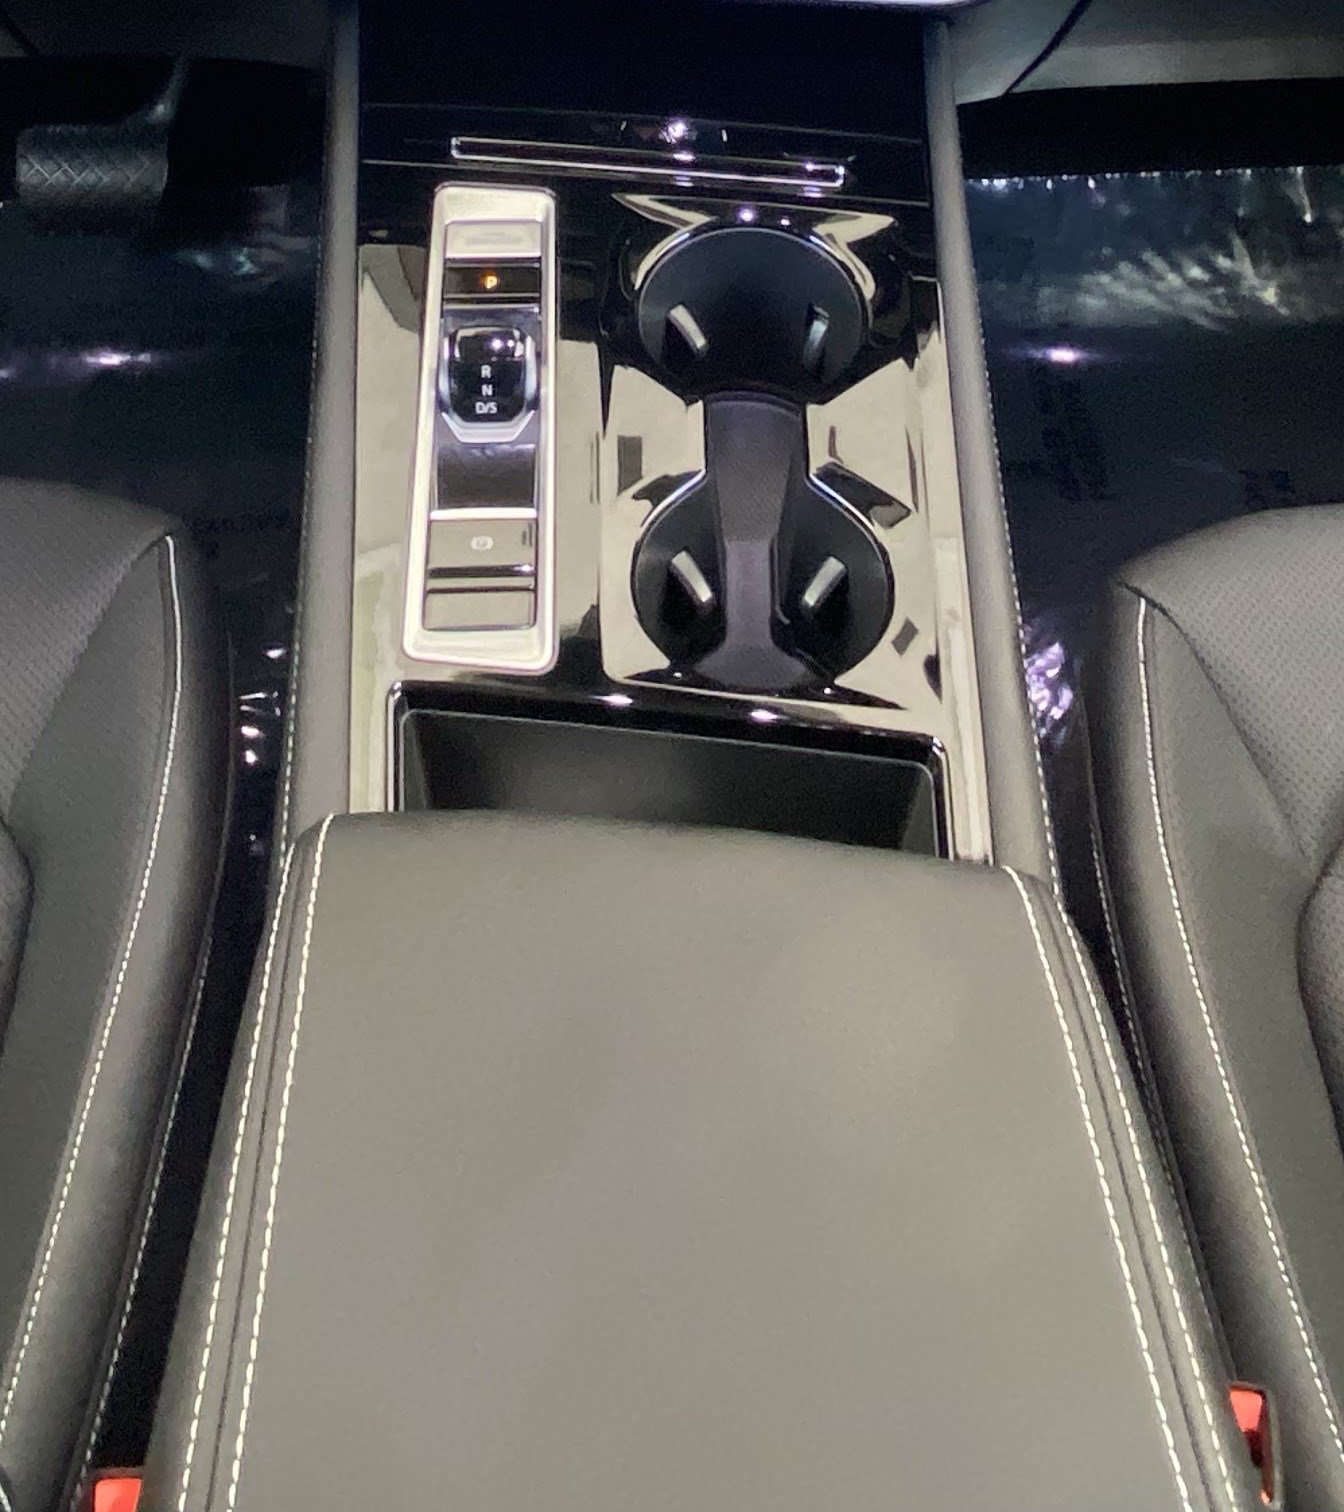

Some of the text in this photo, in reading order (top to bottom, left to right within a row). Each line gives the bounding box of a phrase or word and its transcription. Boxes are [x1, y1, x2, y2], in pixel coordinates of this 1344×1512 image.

[484, 274, 499, 289] P
[480, 364, 492, 378] R
[482, 384, 494, 397] N
[475, 402, 498, 414] D/S
